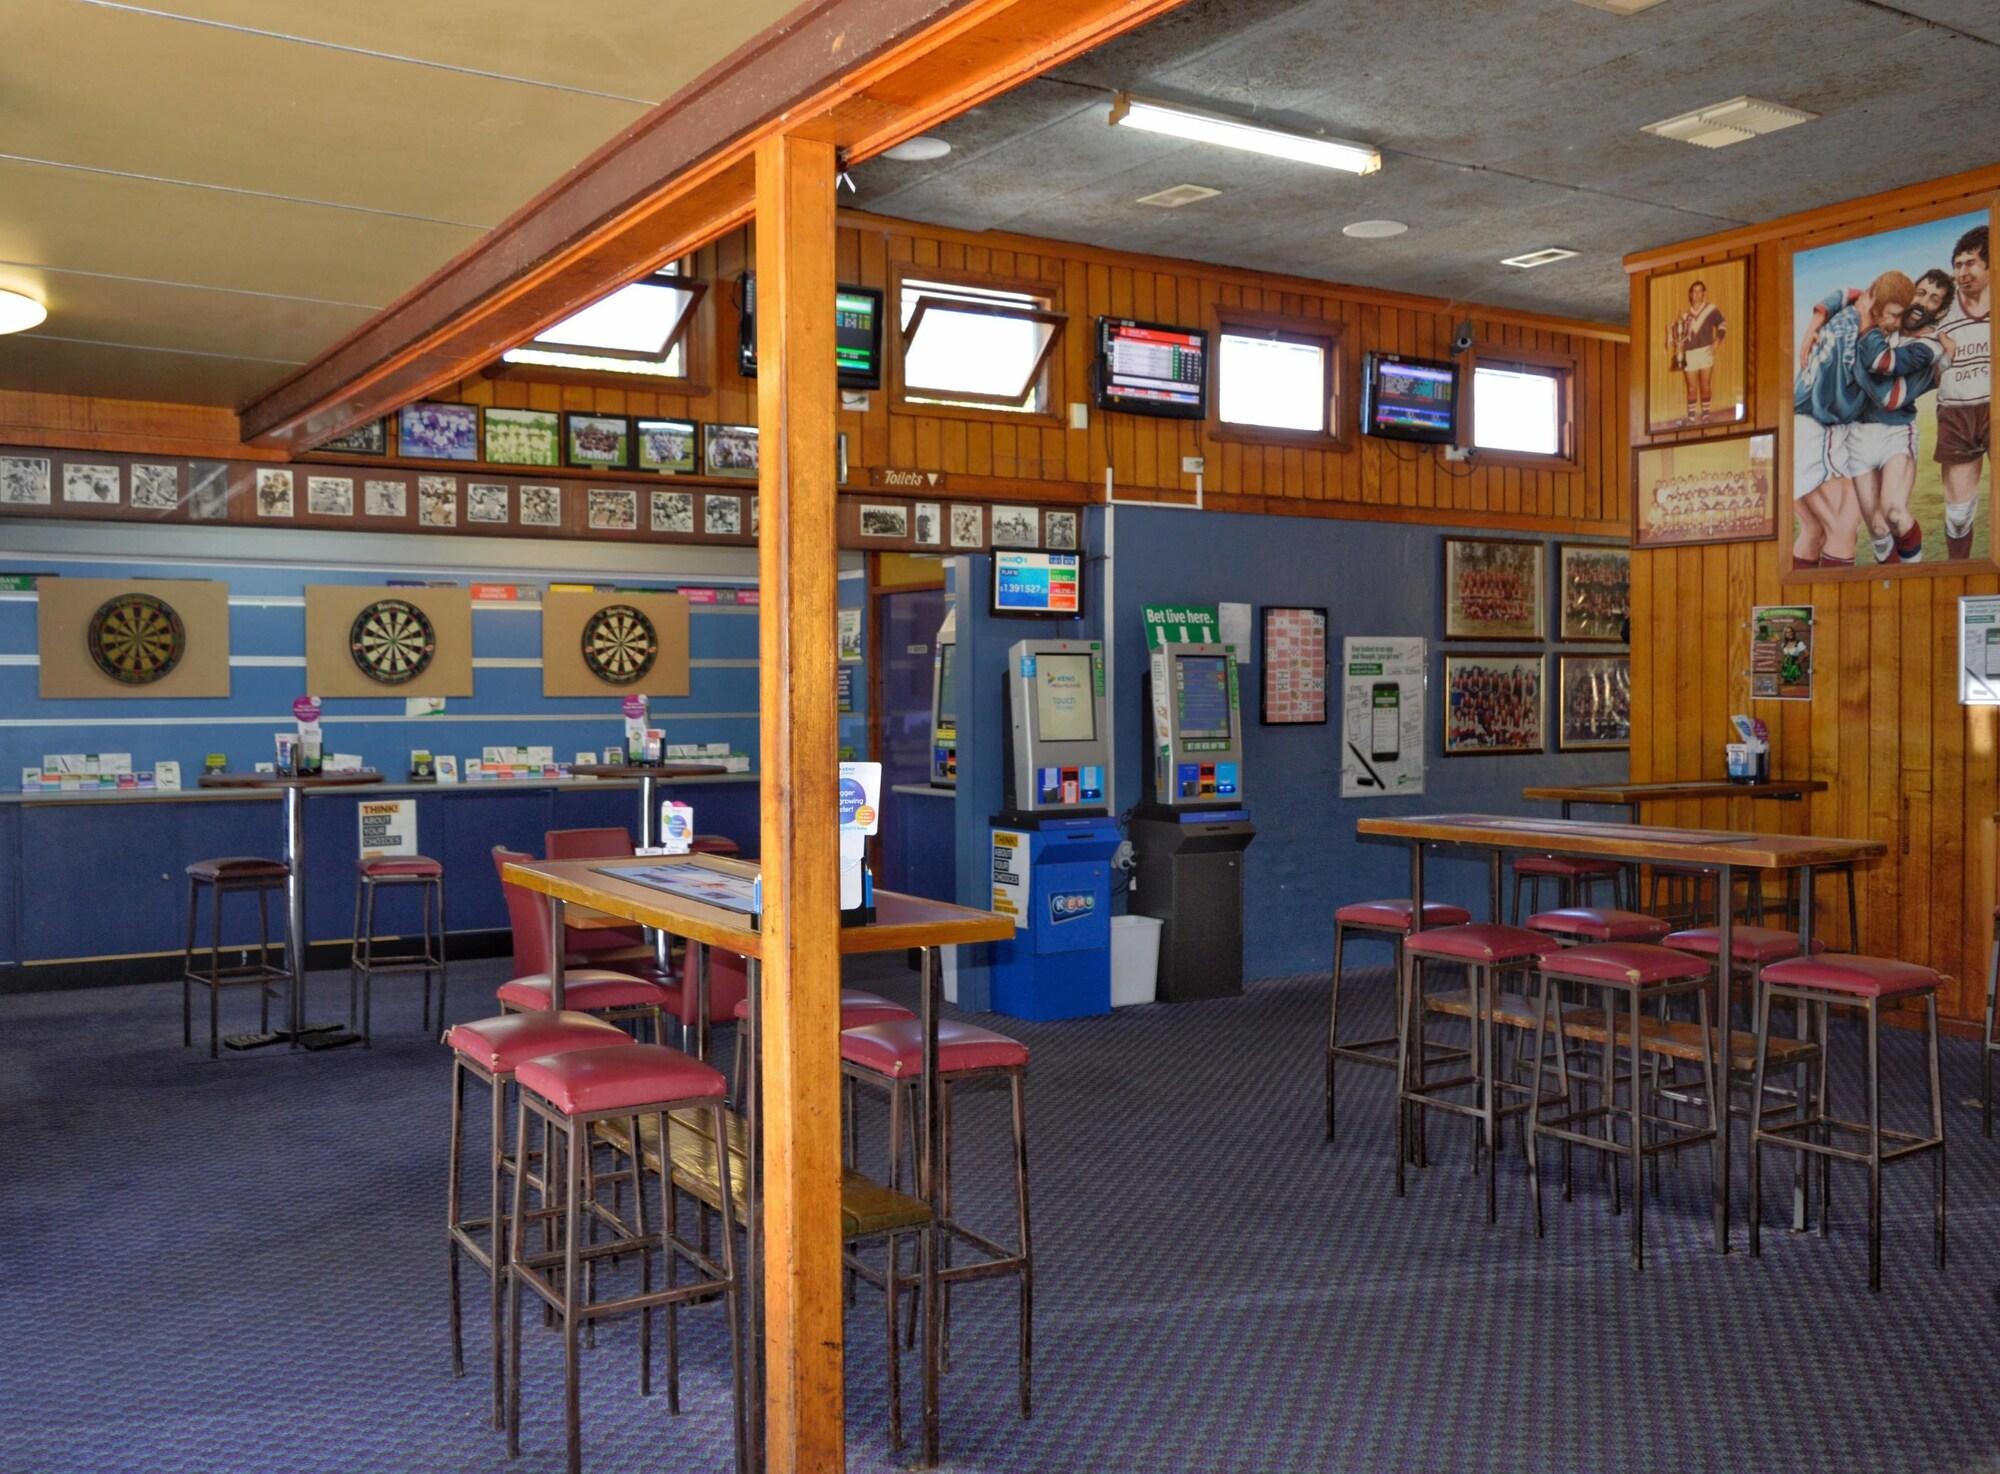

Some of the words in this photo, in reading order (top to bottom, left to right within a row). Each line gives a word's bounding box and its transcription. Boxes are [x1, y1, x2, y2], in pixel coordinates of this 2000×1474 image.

[884, 469, 924, 486] Toilets
[1146, 608, 1165, 623] Bet
[1166, 608, 1186, 624] live
[1186, 609, 1214, 624] here.
[363, 804, 400, 814] THINK!
[364, 816, 391, 825] ABOUT
[364, 827, 386, 836] YOUR
[364, 837, 401, 847] CHOICES
[994, 848, 1012, 858] ABOUT
[994, 860, 1009, 870] YOUR
[993, 872, 1019, 885] CHOICES
